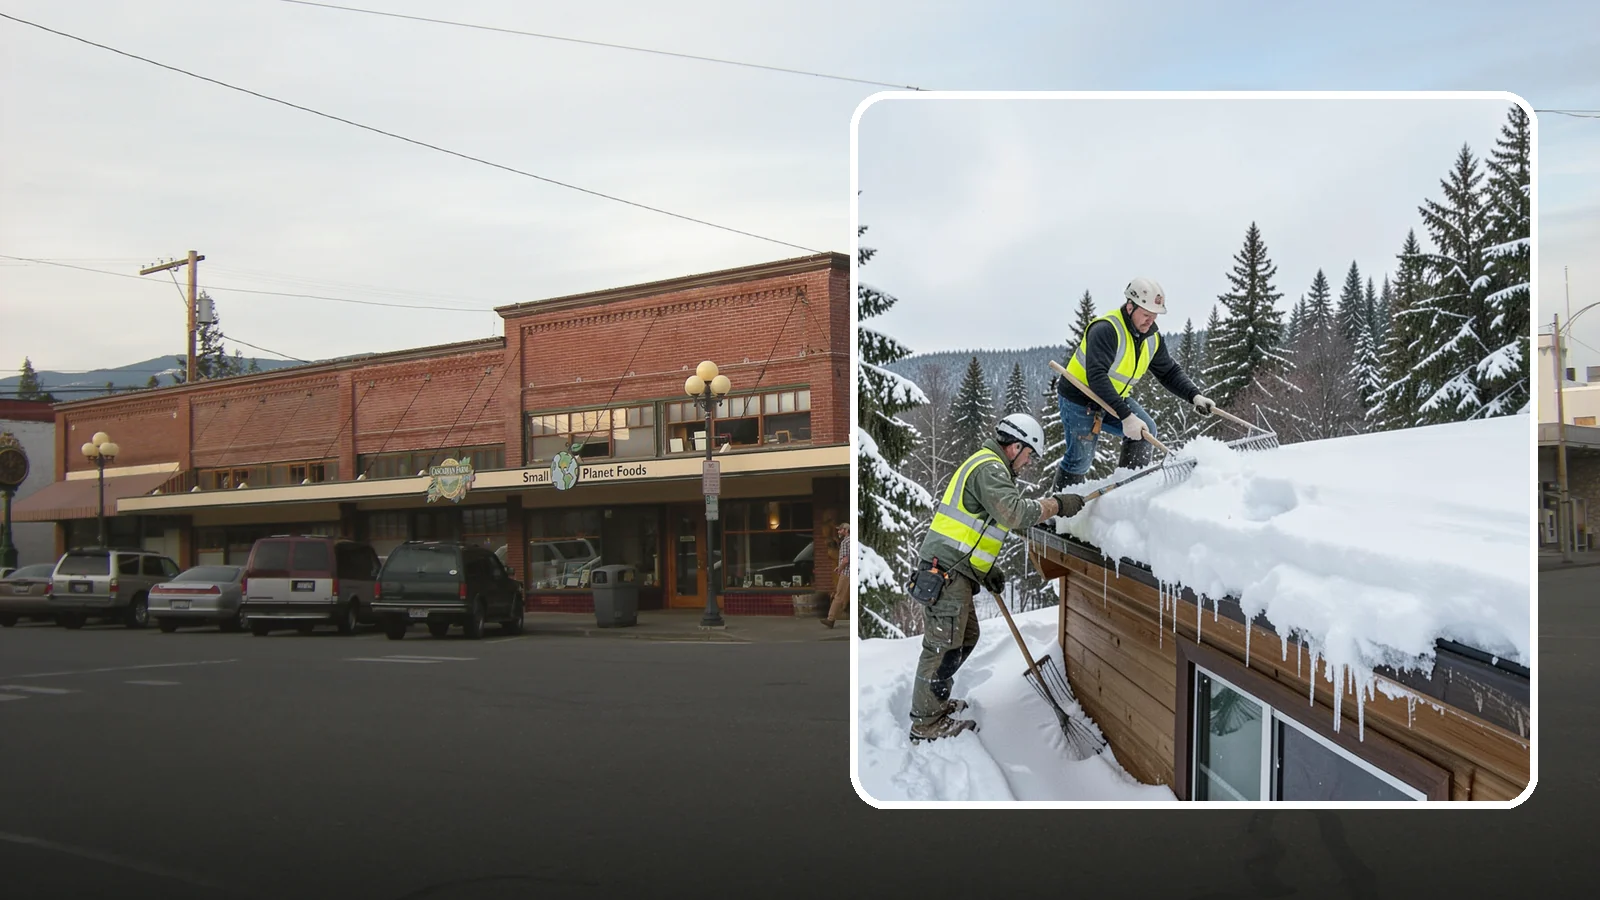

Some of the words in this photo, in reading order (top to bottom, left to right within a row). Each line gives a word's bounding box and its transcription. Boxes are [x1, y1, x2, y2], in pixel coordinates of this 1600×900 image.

[523, 471, 549, 483] Small
[582, 468, 614, 479] Planet
[617, 464, 647, 477] Foods
